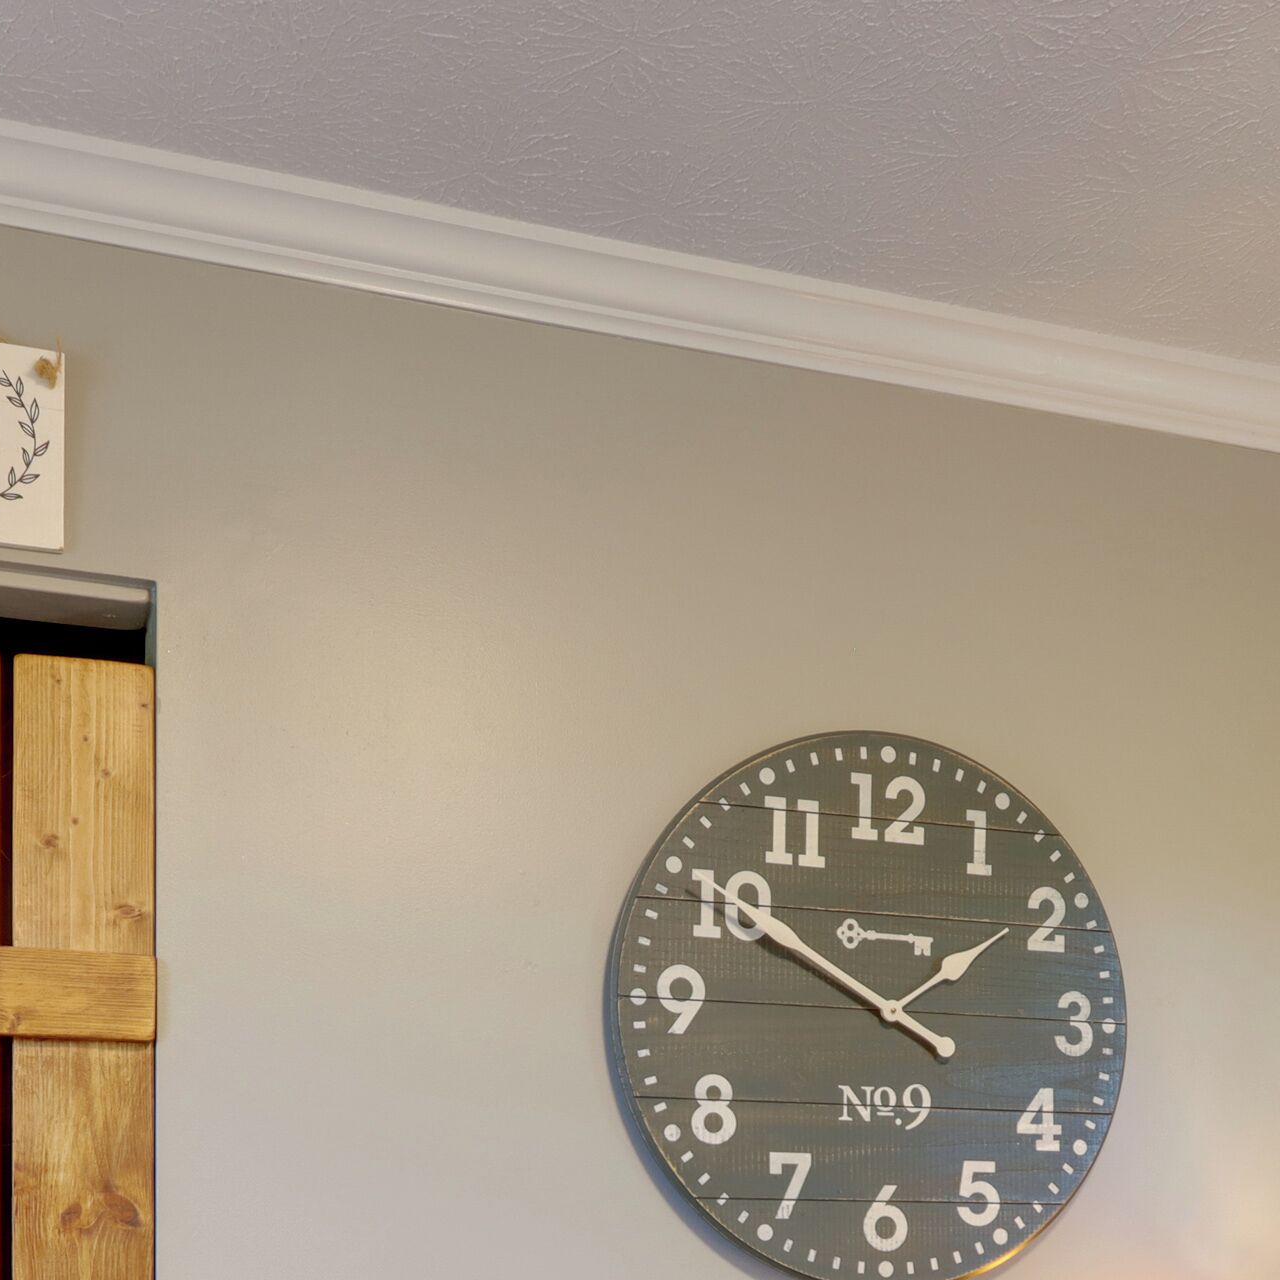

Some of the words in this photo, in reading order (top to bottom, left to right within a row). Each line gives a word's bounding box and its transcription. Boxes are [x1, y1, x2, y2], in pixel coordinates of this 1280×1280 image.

[765, 796, 825, 868] 11
[851, 772, 926, 845] 12
[966, 810, 992, 876] 1
[691, 869, 772, 941] 10
[1027, 887, 1066, 952] 2
[657, 964, 705, 1034] 9
[1054, 991, 1093, 1056] 3
[691, 1074, 736, 1144] 8
[1017, 1088, 1062, 1151] 4
[769, 1152, 812, 1219] 7
[863, 1185, 908, 1251] 6
[957, 1161, 1001, 1226] 5
